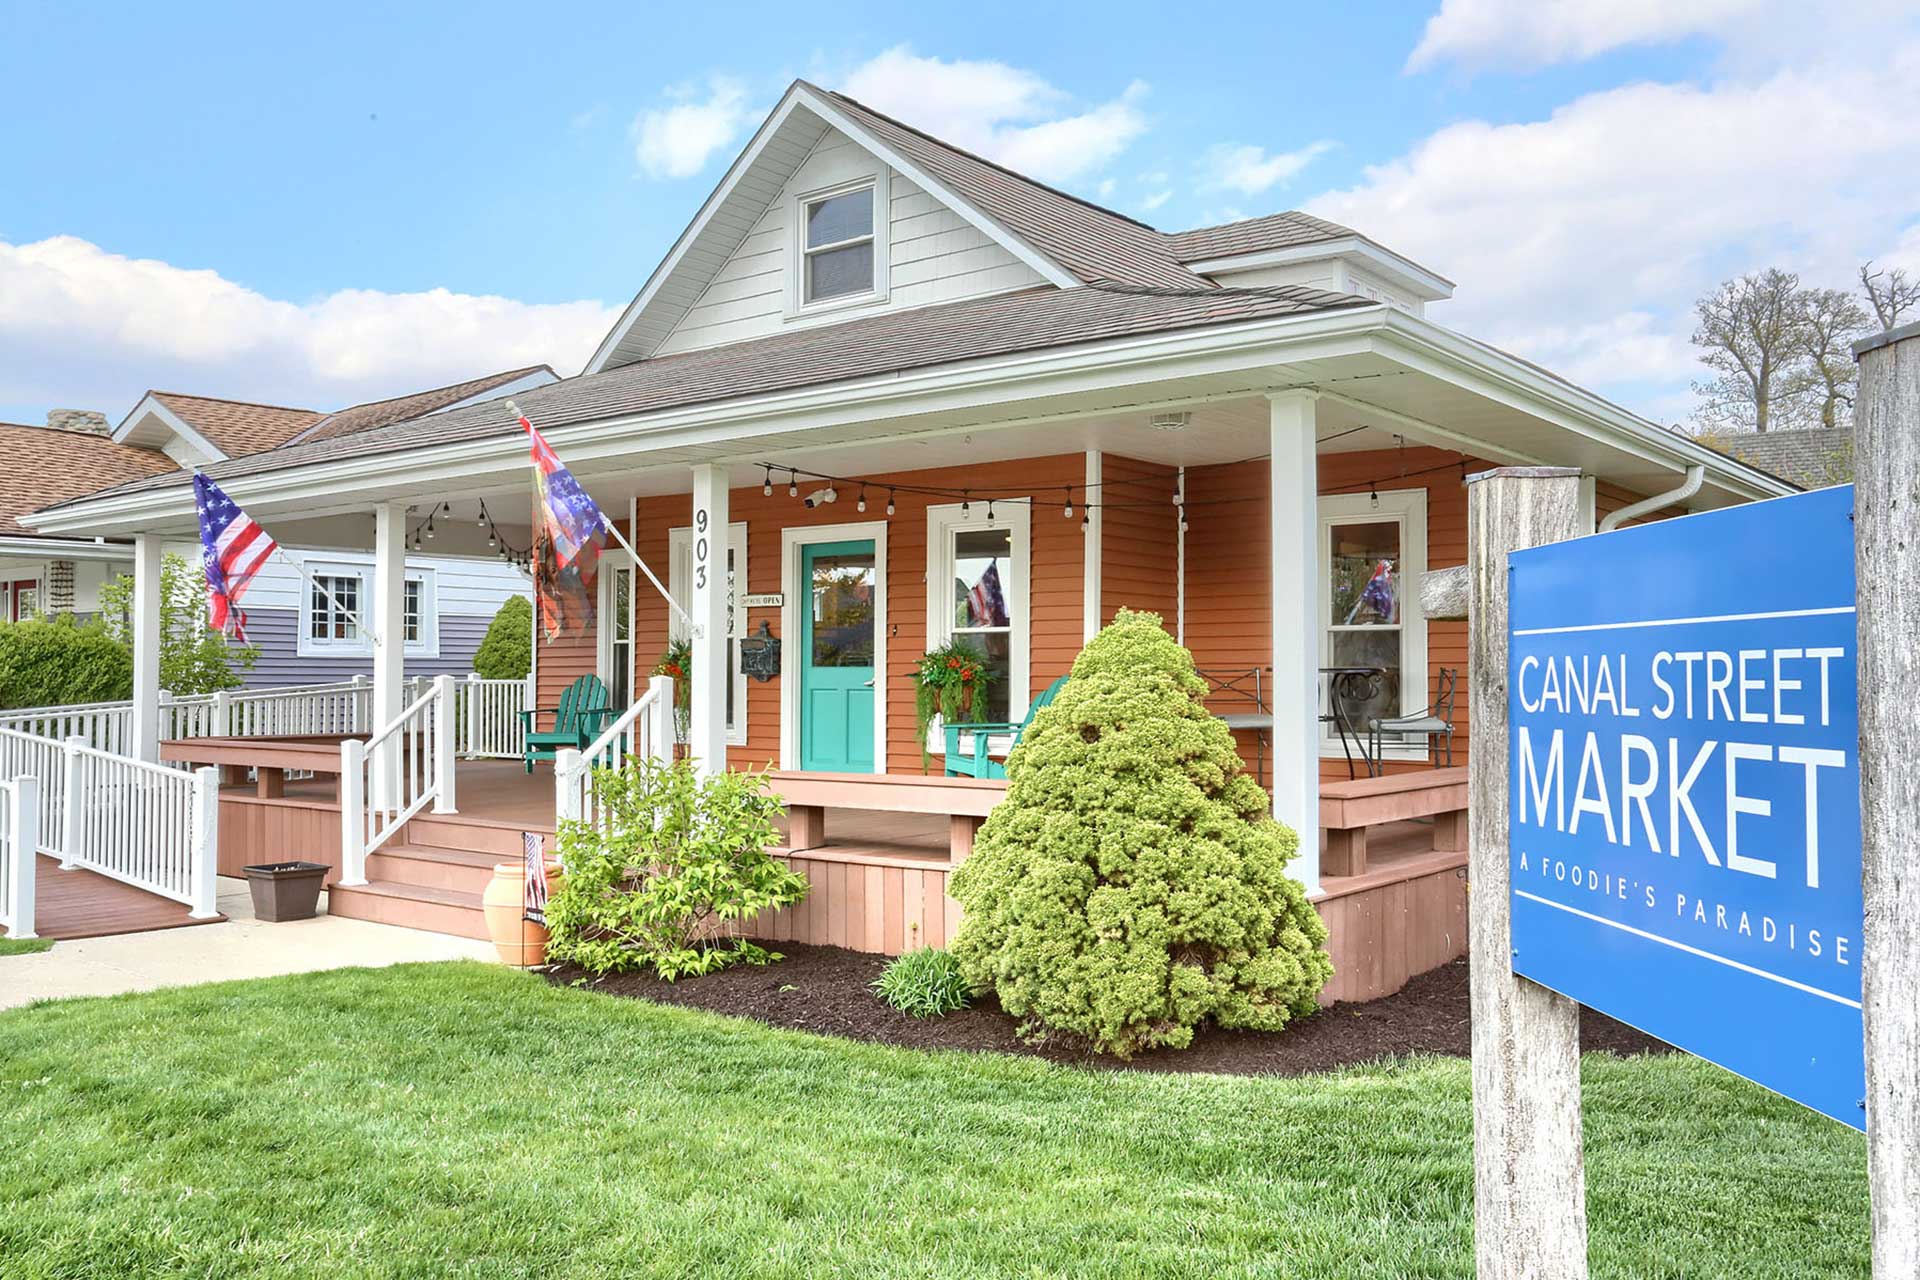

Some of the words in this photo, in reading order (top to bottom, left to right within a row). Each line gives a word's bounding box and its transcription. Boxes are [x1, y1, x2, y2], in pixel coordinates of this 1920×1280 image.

[696, 509, 708, 589] 903
[762, 596, 781, 605] OPEN
[1518, 654, 1640, 717] CANAL
[1651, 647, 1845, 726] STREET
[1518, 726, 1846, 889] MARKET
[1520, 852, 1529, 872] A
[1542, 857, 1656, 908] FOODIE'S
[1677, 893, 1850, 965] PARADISE
